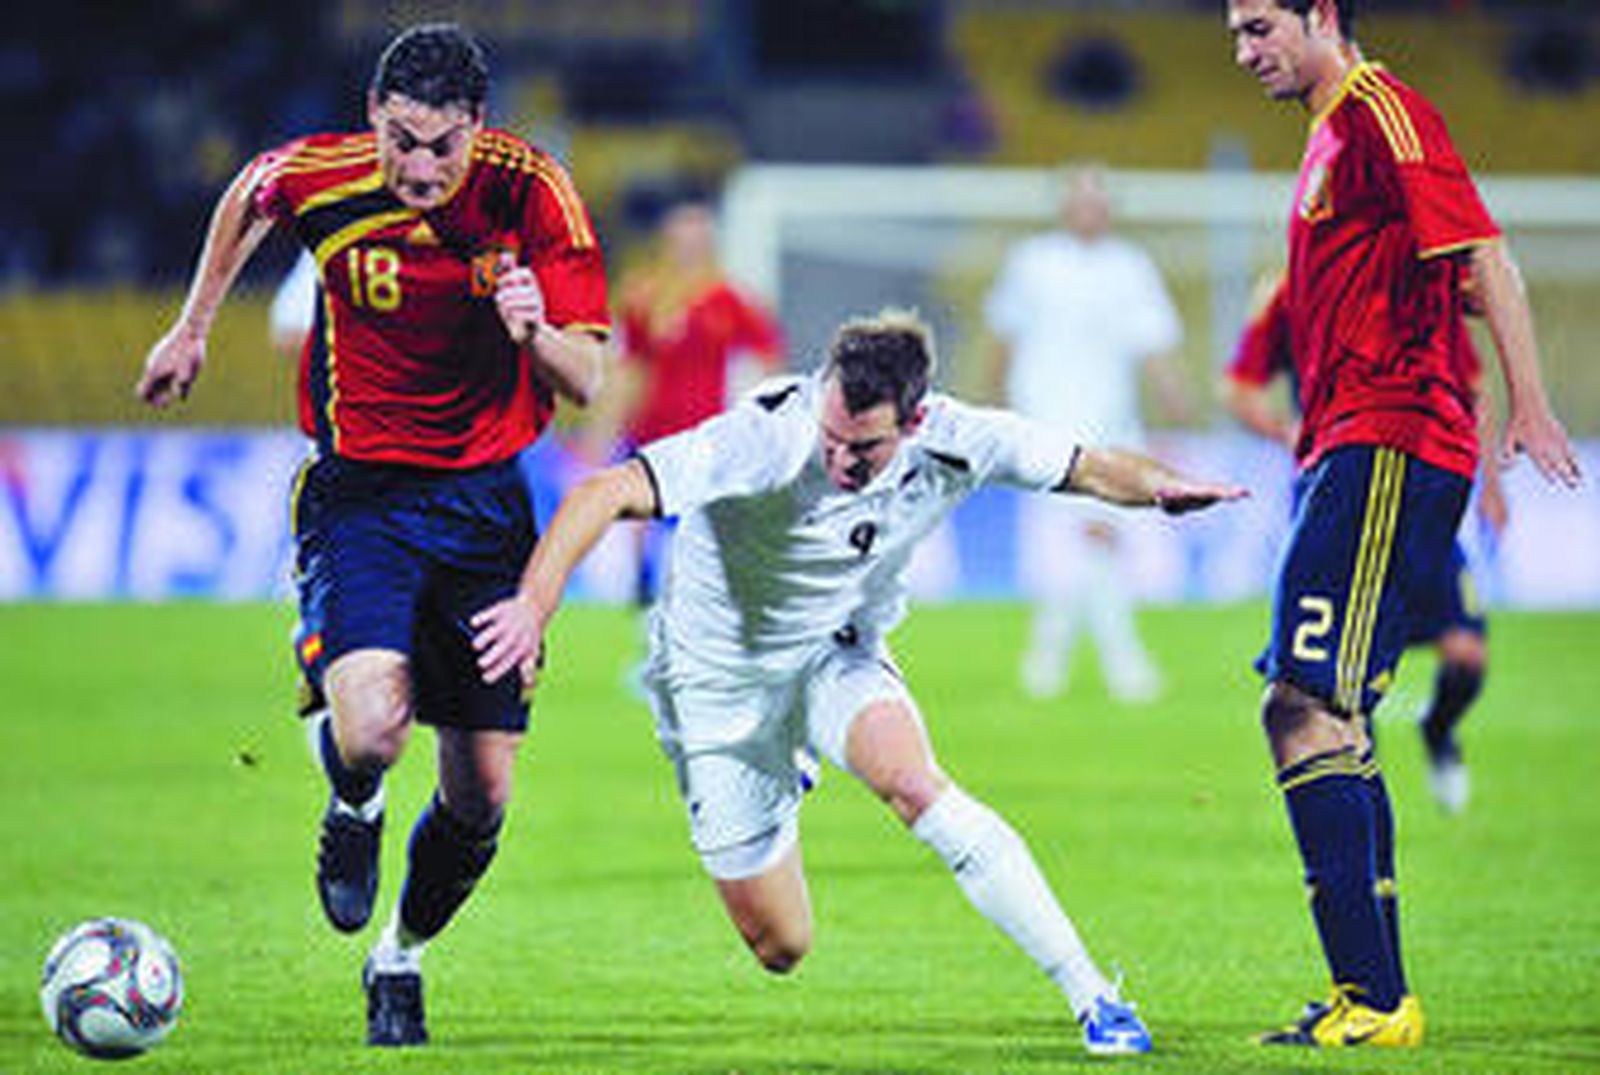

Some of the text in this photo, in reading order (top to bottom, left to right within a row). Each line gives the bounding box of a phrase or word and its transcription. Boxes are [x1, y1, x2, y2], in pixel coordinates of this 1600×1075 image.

[348, 248, 401, 310] 18
[0, 435, 288, 594] VIS
[850, 520, 878, 562] 9
[1293, 597, 1333, 661] 2
